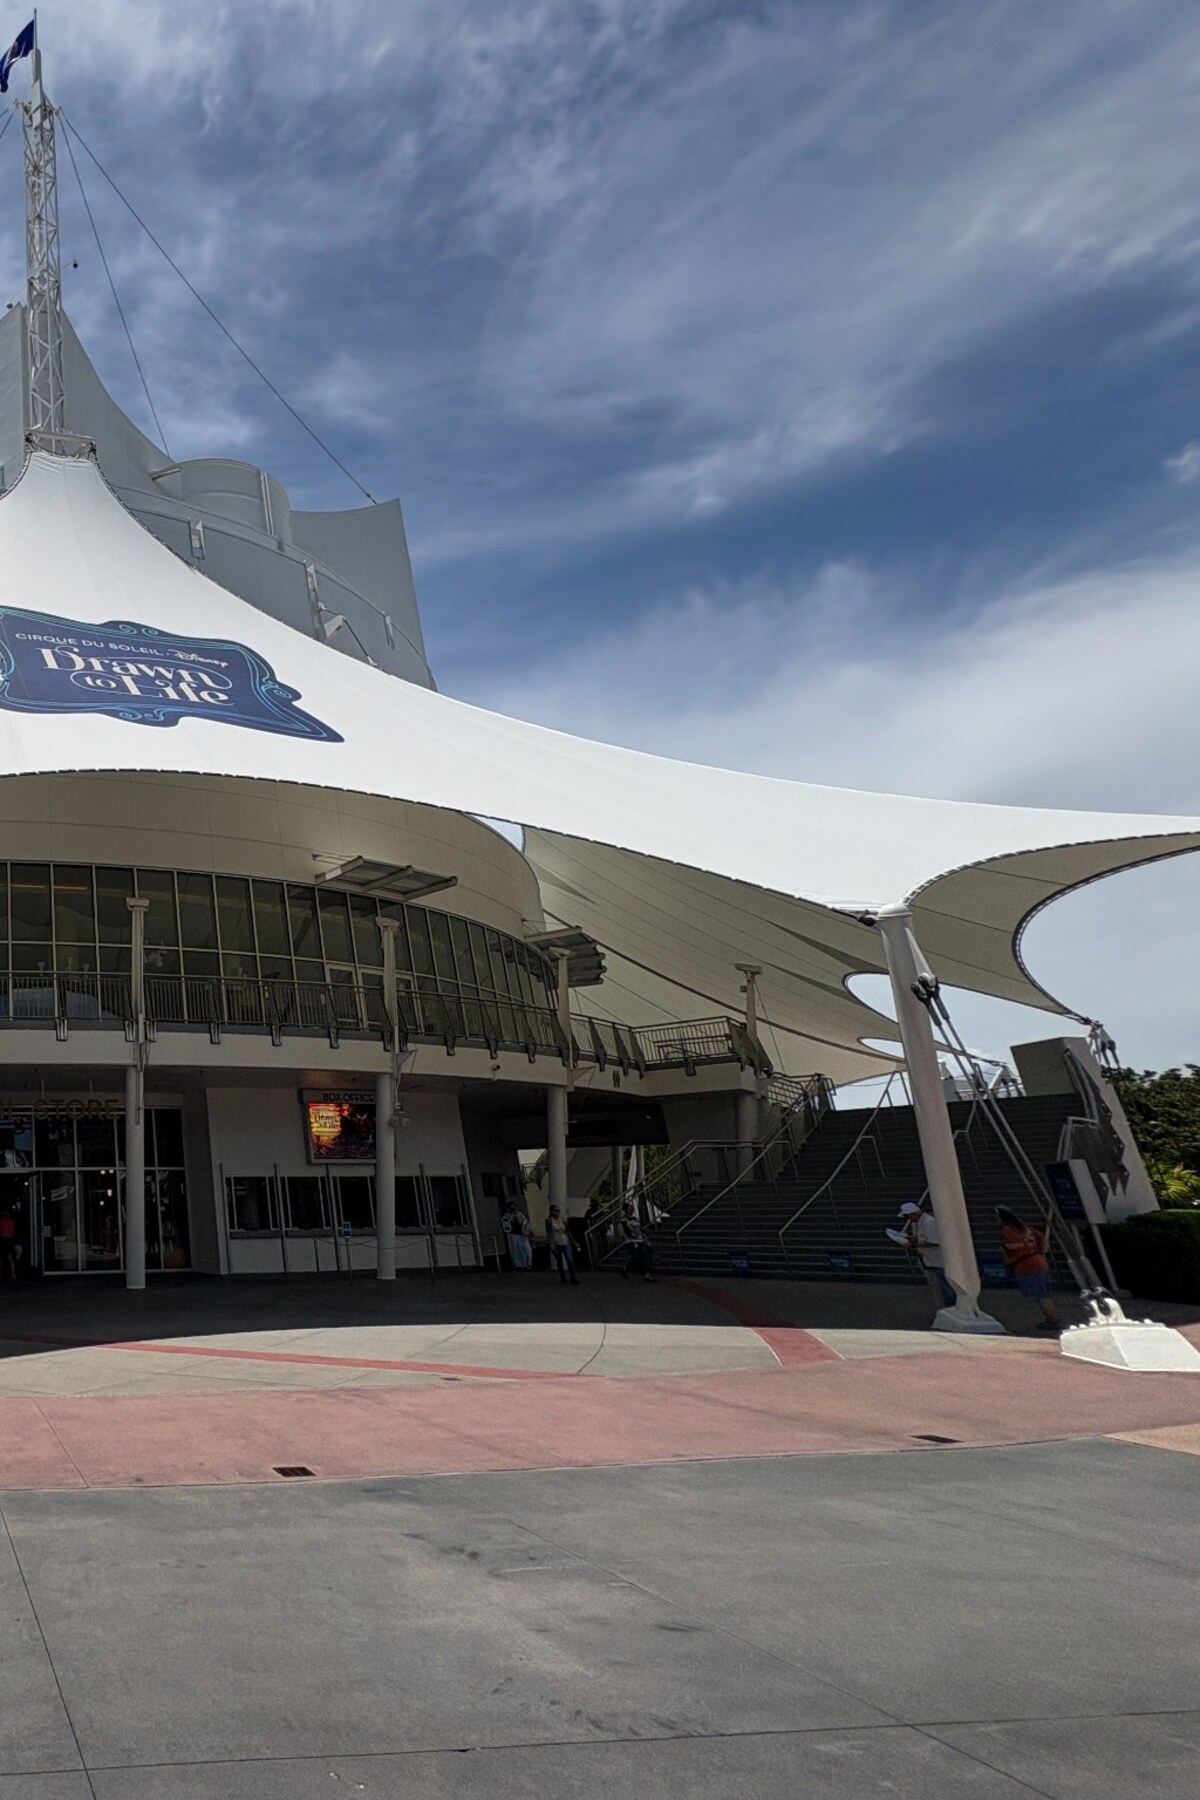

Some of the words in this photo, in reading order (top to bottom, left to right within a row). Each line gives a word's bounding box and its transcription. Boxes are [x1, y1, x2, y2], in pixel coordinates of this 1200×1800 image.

[15, 632, 78, 646] CIRQUE
[82, 639, 104, 648] DU
[108, 642, 163, 656] SOLEIL
[167, 648, 229, 668] Disney
[36, 646, 233, 690] Drawn
[84, 674, 118, 690] to
[120, 674, 235, 707] Life
[33, 1098, 120, 1121] STORE
[322, 1092, 342, 1102] BOX
[343, 1092, 374, 1102] OFFICE
